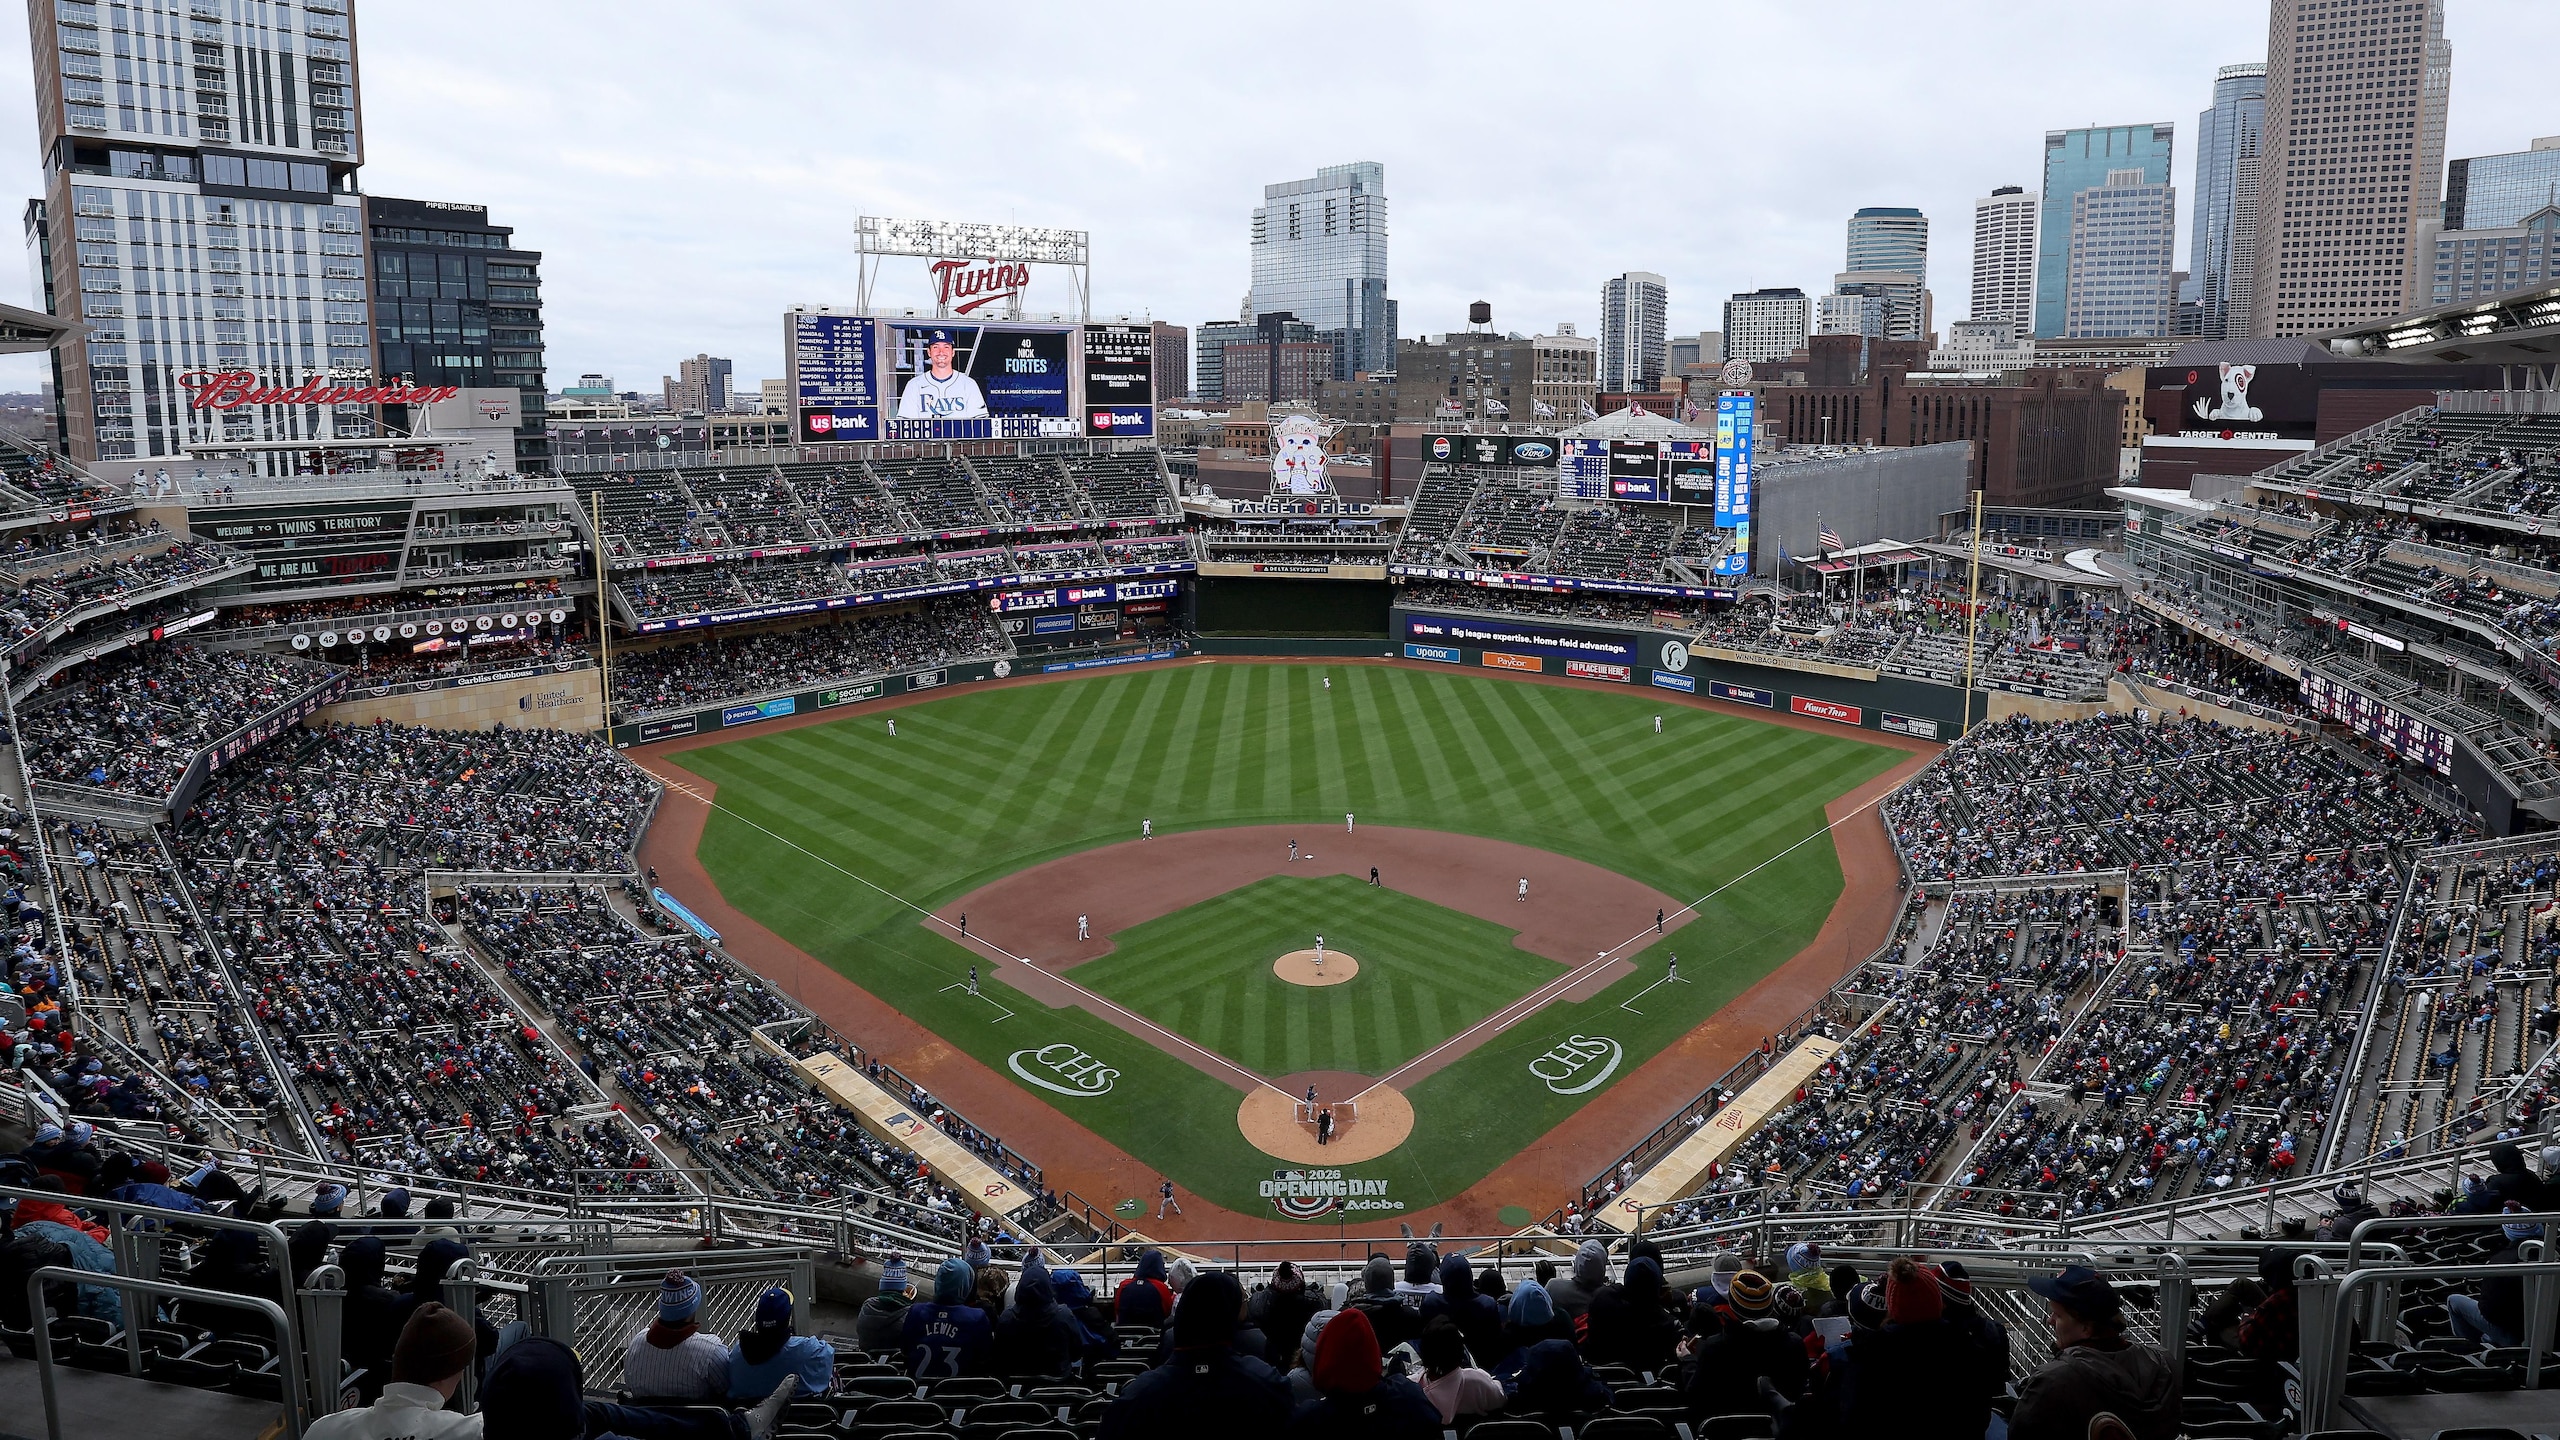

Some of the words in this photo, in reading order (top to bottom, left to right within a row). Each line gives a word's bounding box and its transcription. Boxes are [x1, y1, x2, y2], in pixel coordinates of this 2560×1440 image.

[451, 204, 483, 212] SANDLER
[931, 257, 1030, 306] Twins
[1021, 339, 1031, 348] 40
[1018, 348, 1035, 358] NICK
[1005, 358, 1048, 373] FORTES
[179, 371, 457, 409] Budweiser
[920, 394, 965, 412] RAYS
[914, 420, 919, 428] 0
[925, 420, 930, 428] 0
[1004, 420, 1009, 428] 3
[1014, 420, 1019, 428] 0
[2179, 431, 2221, 439] TARGET
[2234, 432, 2277, 440] CENTER
[1598, 440, 1607, 450] 40
[1522, 447, 1545, 457] Ford
[1233, 503, 1302, 514] TARGET
[1321, 504, 1372, 514] FIELD
[217, 526, 254, 537] WELCOME
[277, 521, 316, 535] TWINS
[323, 517, 382, 530] TERRITORY
[856, 540, 880, 548] Treasure
[881, 538, 897, 546] Island
[1962, 541, 2005, 553] TARGET
[2018, 548, 2052, 559] FIELD
[654, 558, 684, 566] Treasure
[685, 556, 707, 564] Island
[260, 565, 277, 578] WE
[280, 564, 299, 576] ARE
[301, 562, 318, 574] ALL
[1604, 583, 1627, 591] expertise.
[890, 591, 905, 599] league
[528, 614, 539, 623] 29
[555, 612, 560, 620] 3
[711, 614, 721, 623] Big
[722, 614, 737, 622] league
[738, 610, 764, 620] expertise.
[790, 604, 817, 613] advantage.
[454, 621, 465, 630] 34
[479, 618, 489, 628] 14
[1016, 620, 1024, 631] 9
[1036, 620, 1072, 629] PROGRESSIVE
[379, 629, 385, 638] 7
[404, 626, 413, 635] 10
[323, 635, 334, 644] 42
[351, 632, 362, 641] 36
[1452, 627, 1464, 638] Big
[1465, 628, 1492, 641] league
[1493, 630, 1532, 644] expertise.
[1533, 635, 1558, 646] Home
[1559, 637, 1578, 649] field
[1579, 639, 1626, 654] advantage.
[296, 637, 305, 647] W
[1416, 648, 1447, 659] uponor
[1497, 656, 1526, 668] Paycor
[1736, 653, 1778, 666] WINNEBAGO
[1778, 658, 1824, 672] INDUSTRIES
[1579, 663, 1599, 673] PLACE
[1608, 667, 1624, 676] HERE
[1881, 663, 1901, 673] Corona
[1905, 667, 1926, 676] Corona
[458, 673, 491, 686] Carbliss
[492, 669, 534, 682] Clubhouse
[1654, 674, 1692, 688] PROGRESSIVE
[1931, 671, 1951, 681] Corona
[1977, 678, 1999, 688] Corona
[838, 684, 875, 700] securian
[1728, 688, 1738, 696] us
[2010, 683, 2032, 694] Corona
[537, 690, 566, 700] United
[2043, 689, 2067, 699] Corona
[537, 696, 584, 709] Healthcare
[733, 710, 757, 719] PENTAIR
[1907, 719, 1935, 731] CHANGING
[1908, 726, 1919, 734] THE
[1919, 727, 1934, 737] GAME
[1528, 1033, 1609, 1082] CHS
[1035, 1042, 1121, 1092] CHS
[1716, 1109, 1741, 1131] Twins
[1308, 1170, 1341, 1180] 2026
[1259, 1180, 1347, 1197] OPENING
[1349, 1180, 1388, 1196] DAY
[1345, 1200, 1404, 1210] Adobe
[925, 1322, 958, 1338] LEWIS
[916, 1344, 962, 1379] 23
